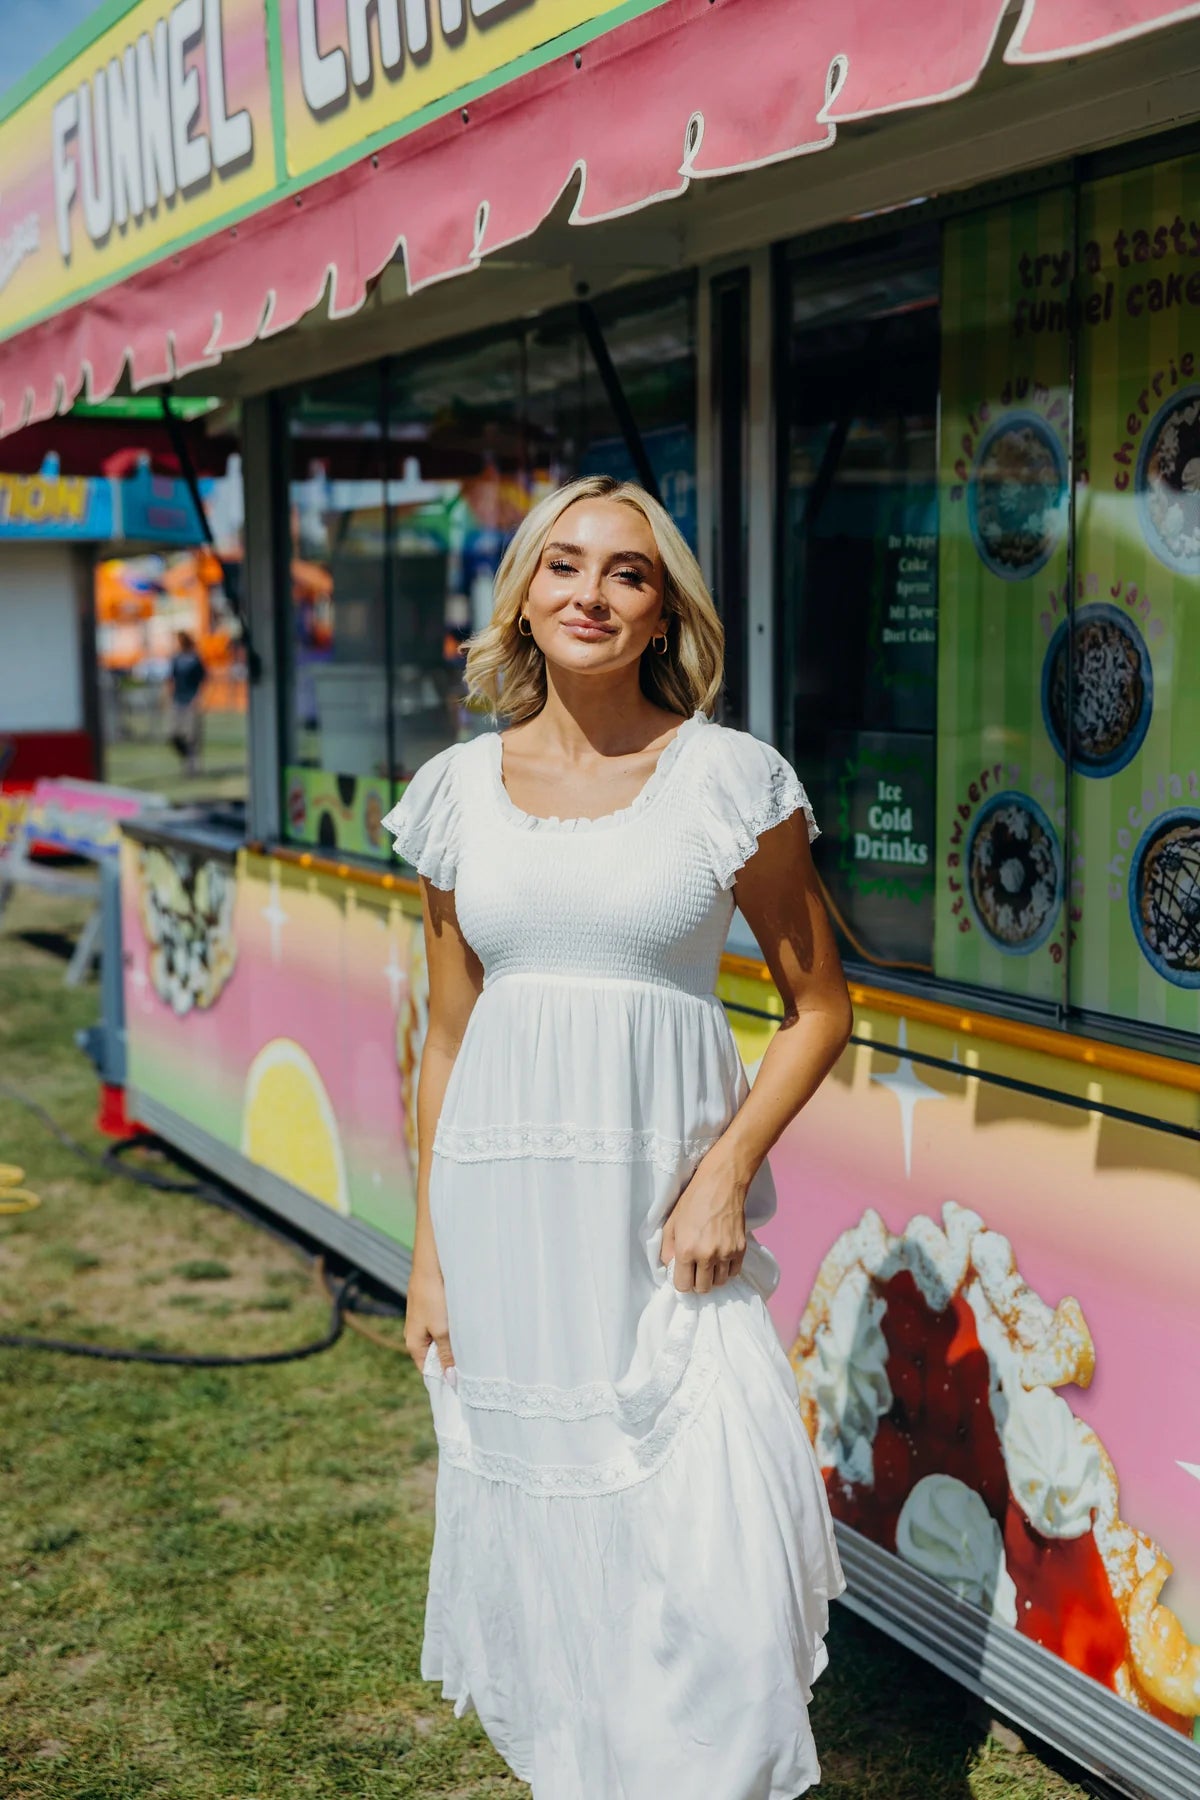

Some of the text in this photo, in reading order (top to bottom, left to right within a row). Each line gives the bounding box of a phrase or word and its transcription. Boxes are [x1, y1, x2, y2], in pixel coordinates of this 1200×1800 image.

[52, 0, 253, 264] FUNNEL
[1018, 215, 1200, 289] try a tasty
[1014, 271, 1200, 338] funel cake
[1113, 350, 1200, 491] cherrie
[868, 804, 913, 832] Cold
[878, 780, 902, 802] Ice
[854, 832, 929, 865] Drinks
